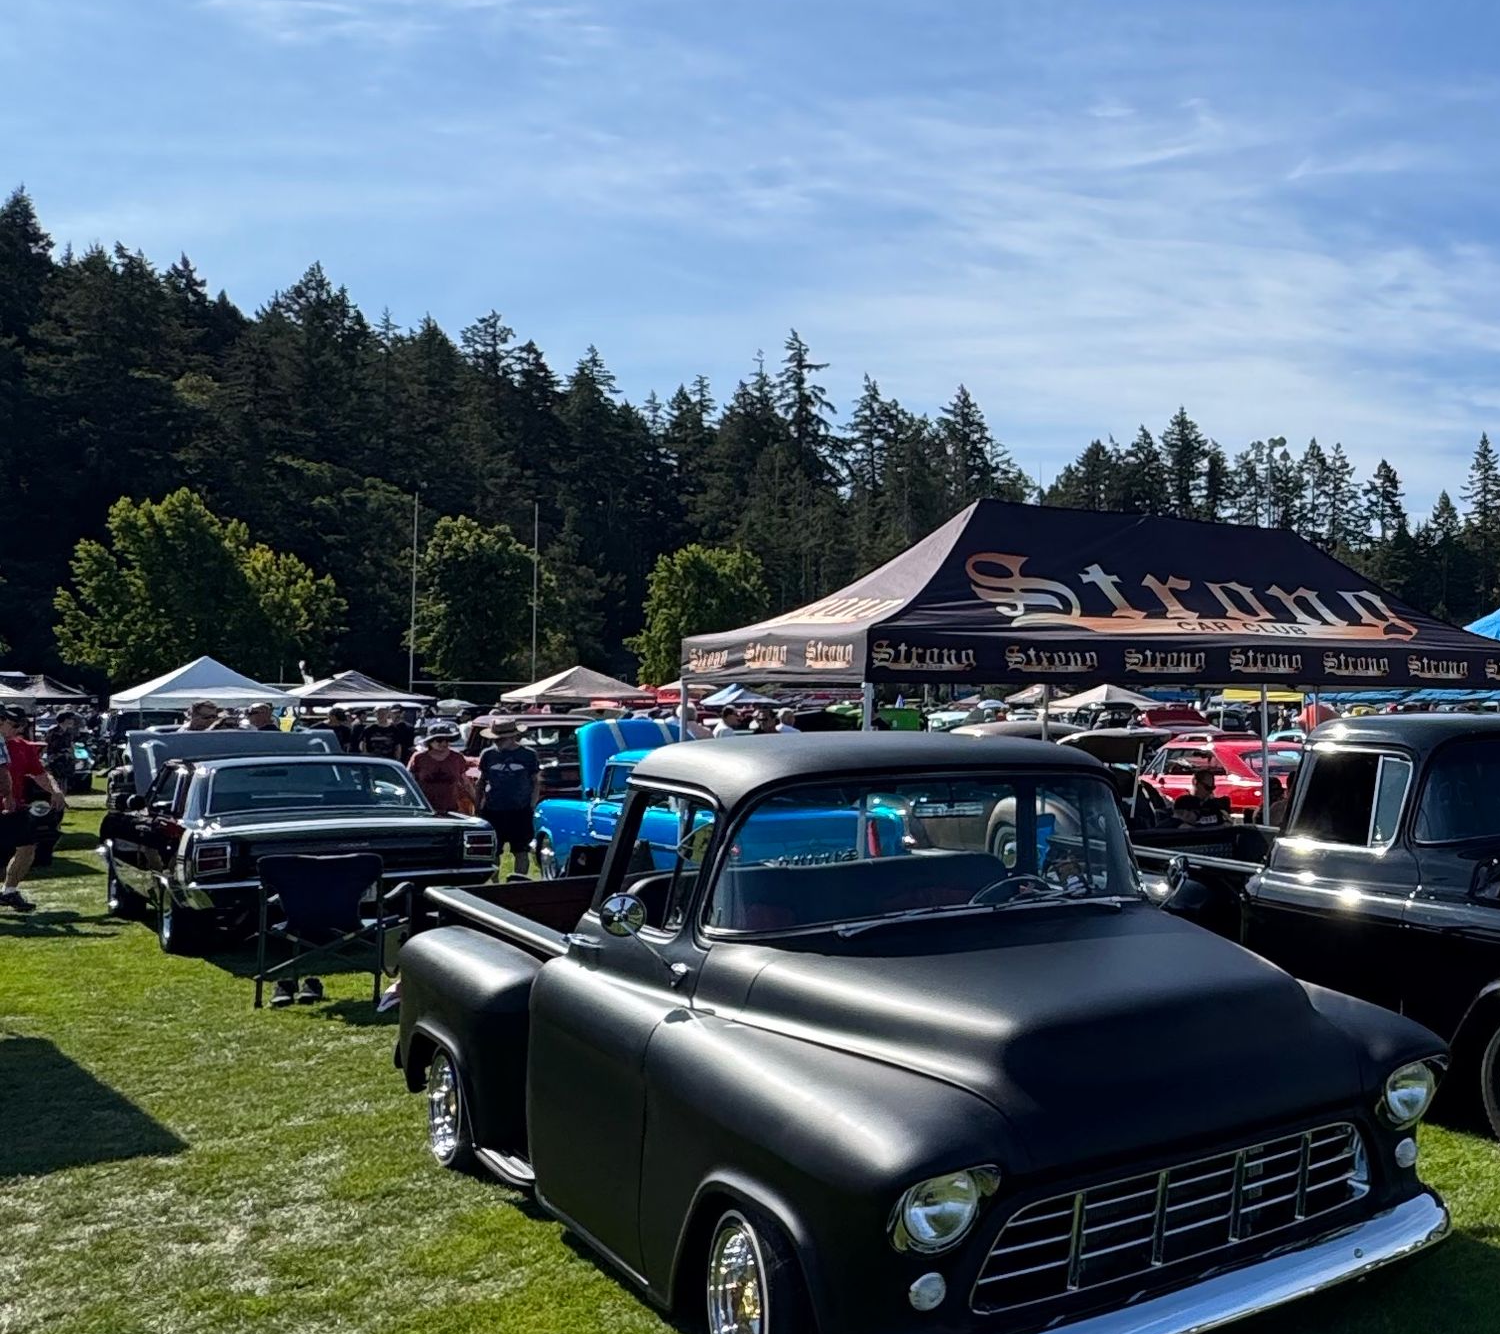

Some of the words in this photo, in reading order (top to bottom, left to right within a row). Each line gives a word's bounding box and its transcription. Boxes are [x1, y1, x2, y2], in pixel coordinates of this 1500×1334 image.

[965, 552, 1418, 642] Strong
[1177, 621, 1233, 632] CAR
[1241, 622, 1307, 635] CLUB
[743, 643, 788, 668] Strong
[805, 640, 854, 668] Strong
[871, 639, 976, 671] Strong
[1004, 645, 1099, 672] Strong
[1124, 648, 1206, 673] Strong
[1229, 648, 1302, 674] Strong
[1323, 652, 1390, 677] Strong
[1407, 655, 1469, 679] Strong
